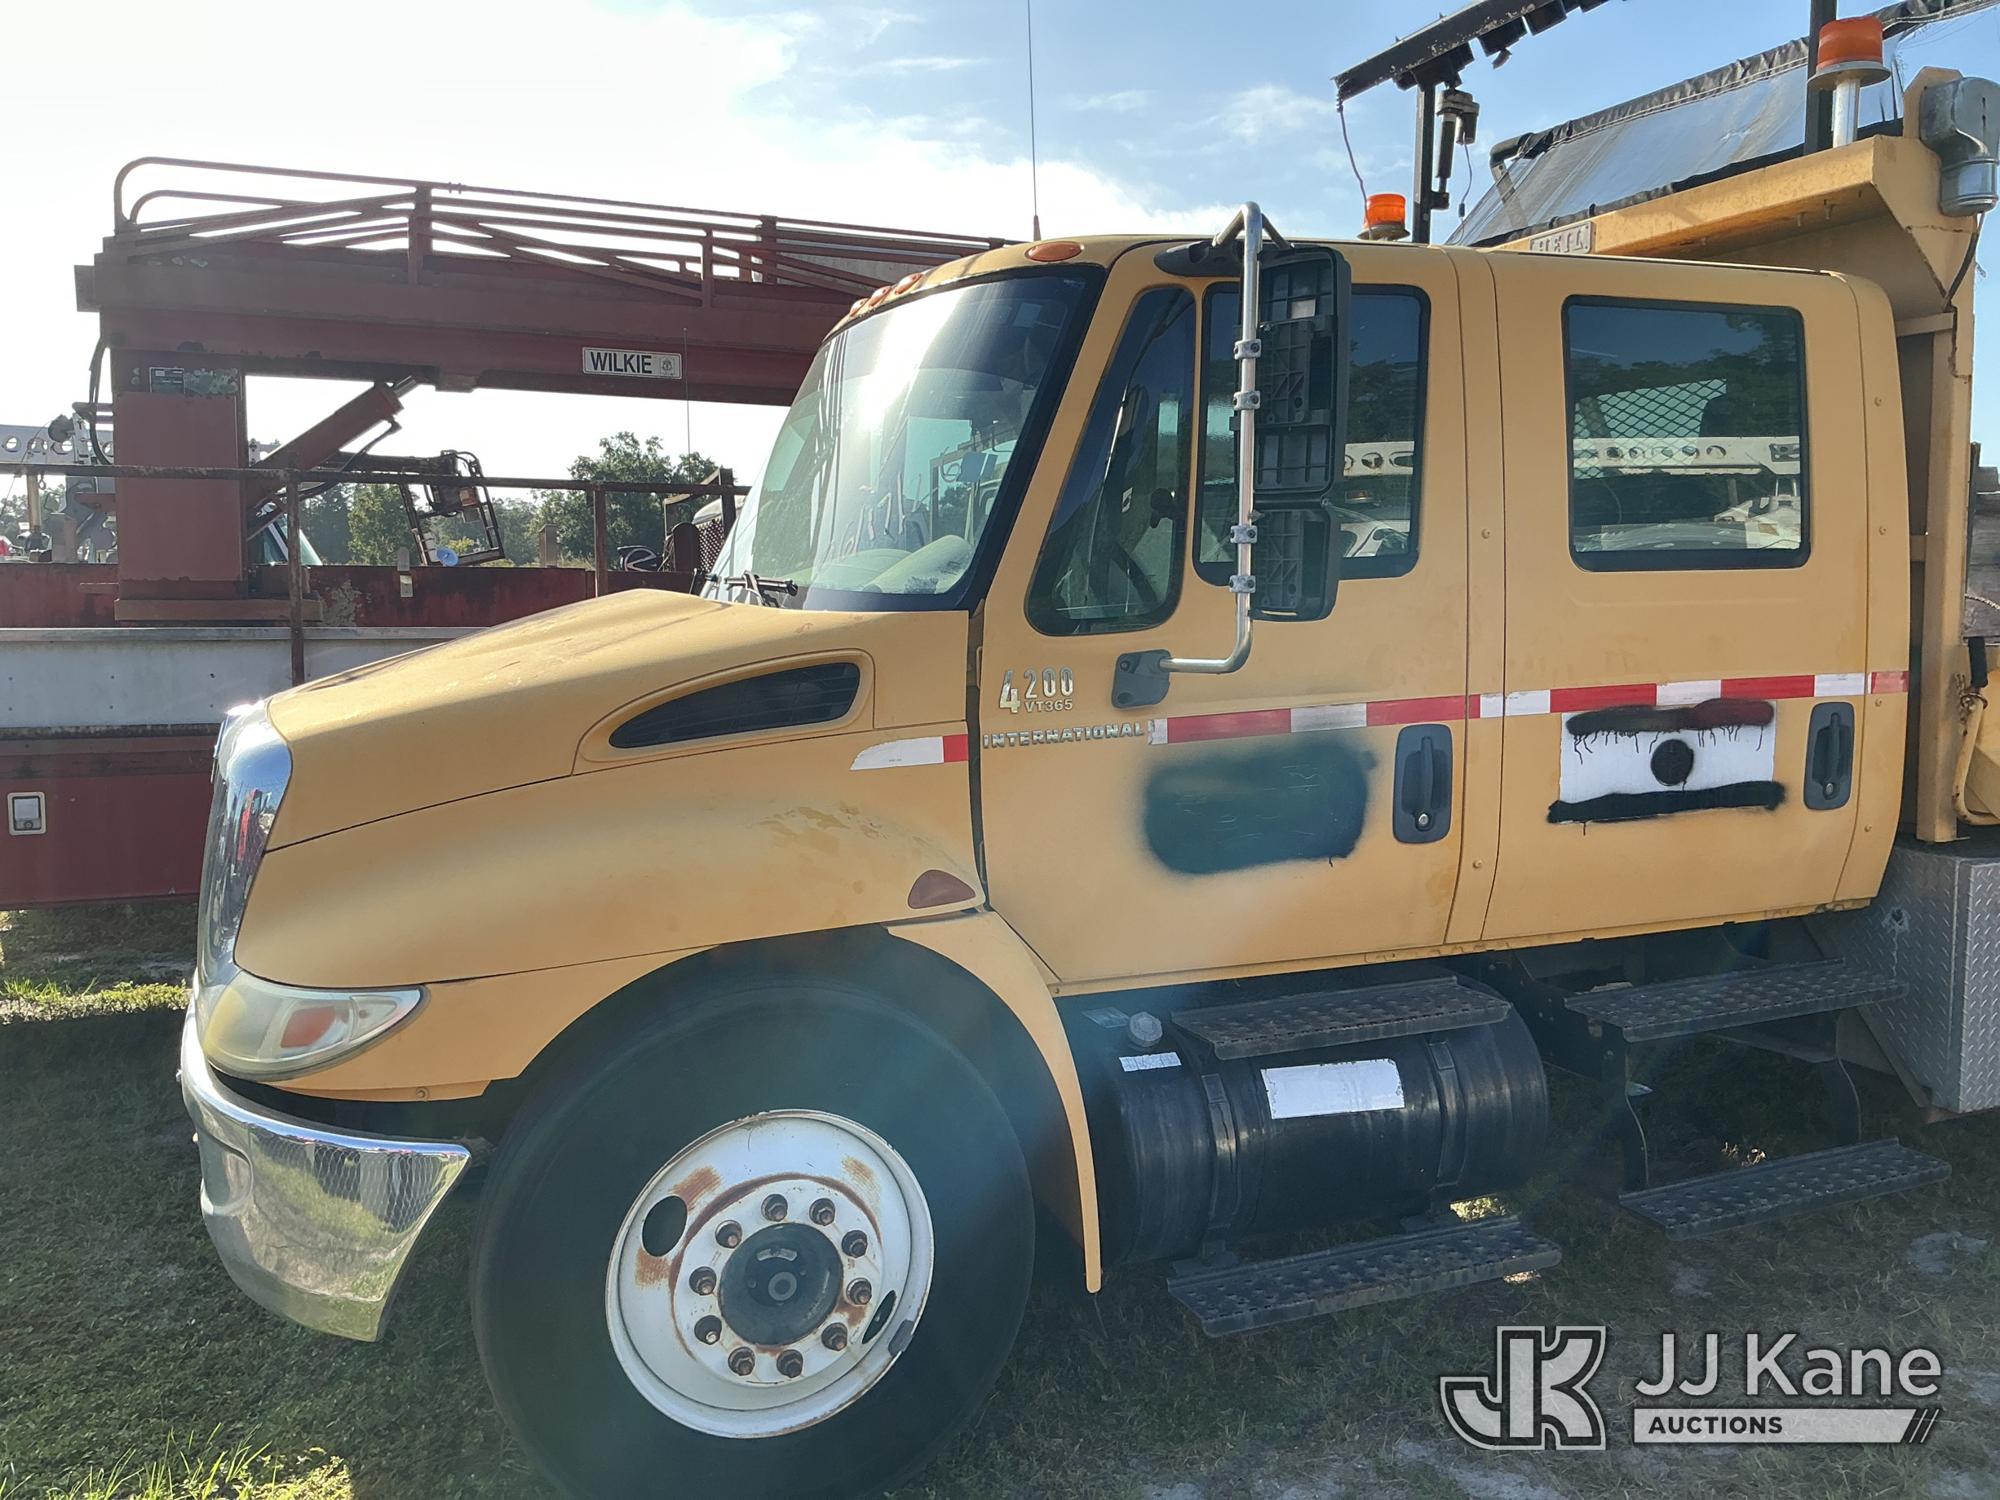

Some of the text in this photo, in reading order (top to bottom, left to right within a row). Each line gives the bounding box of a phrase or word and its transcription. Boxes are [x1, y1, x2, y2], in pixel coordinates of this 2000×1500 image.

[590, 351, 652, 374] WILKIE
[999, 666, 1075, 714] 4200
[1024, 698, 1074, 714] VT365
[983, 722, 1145, 749] INTERNATIONAL
